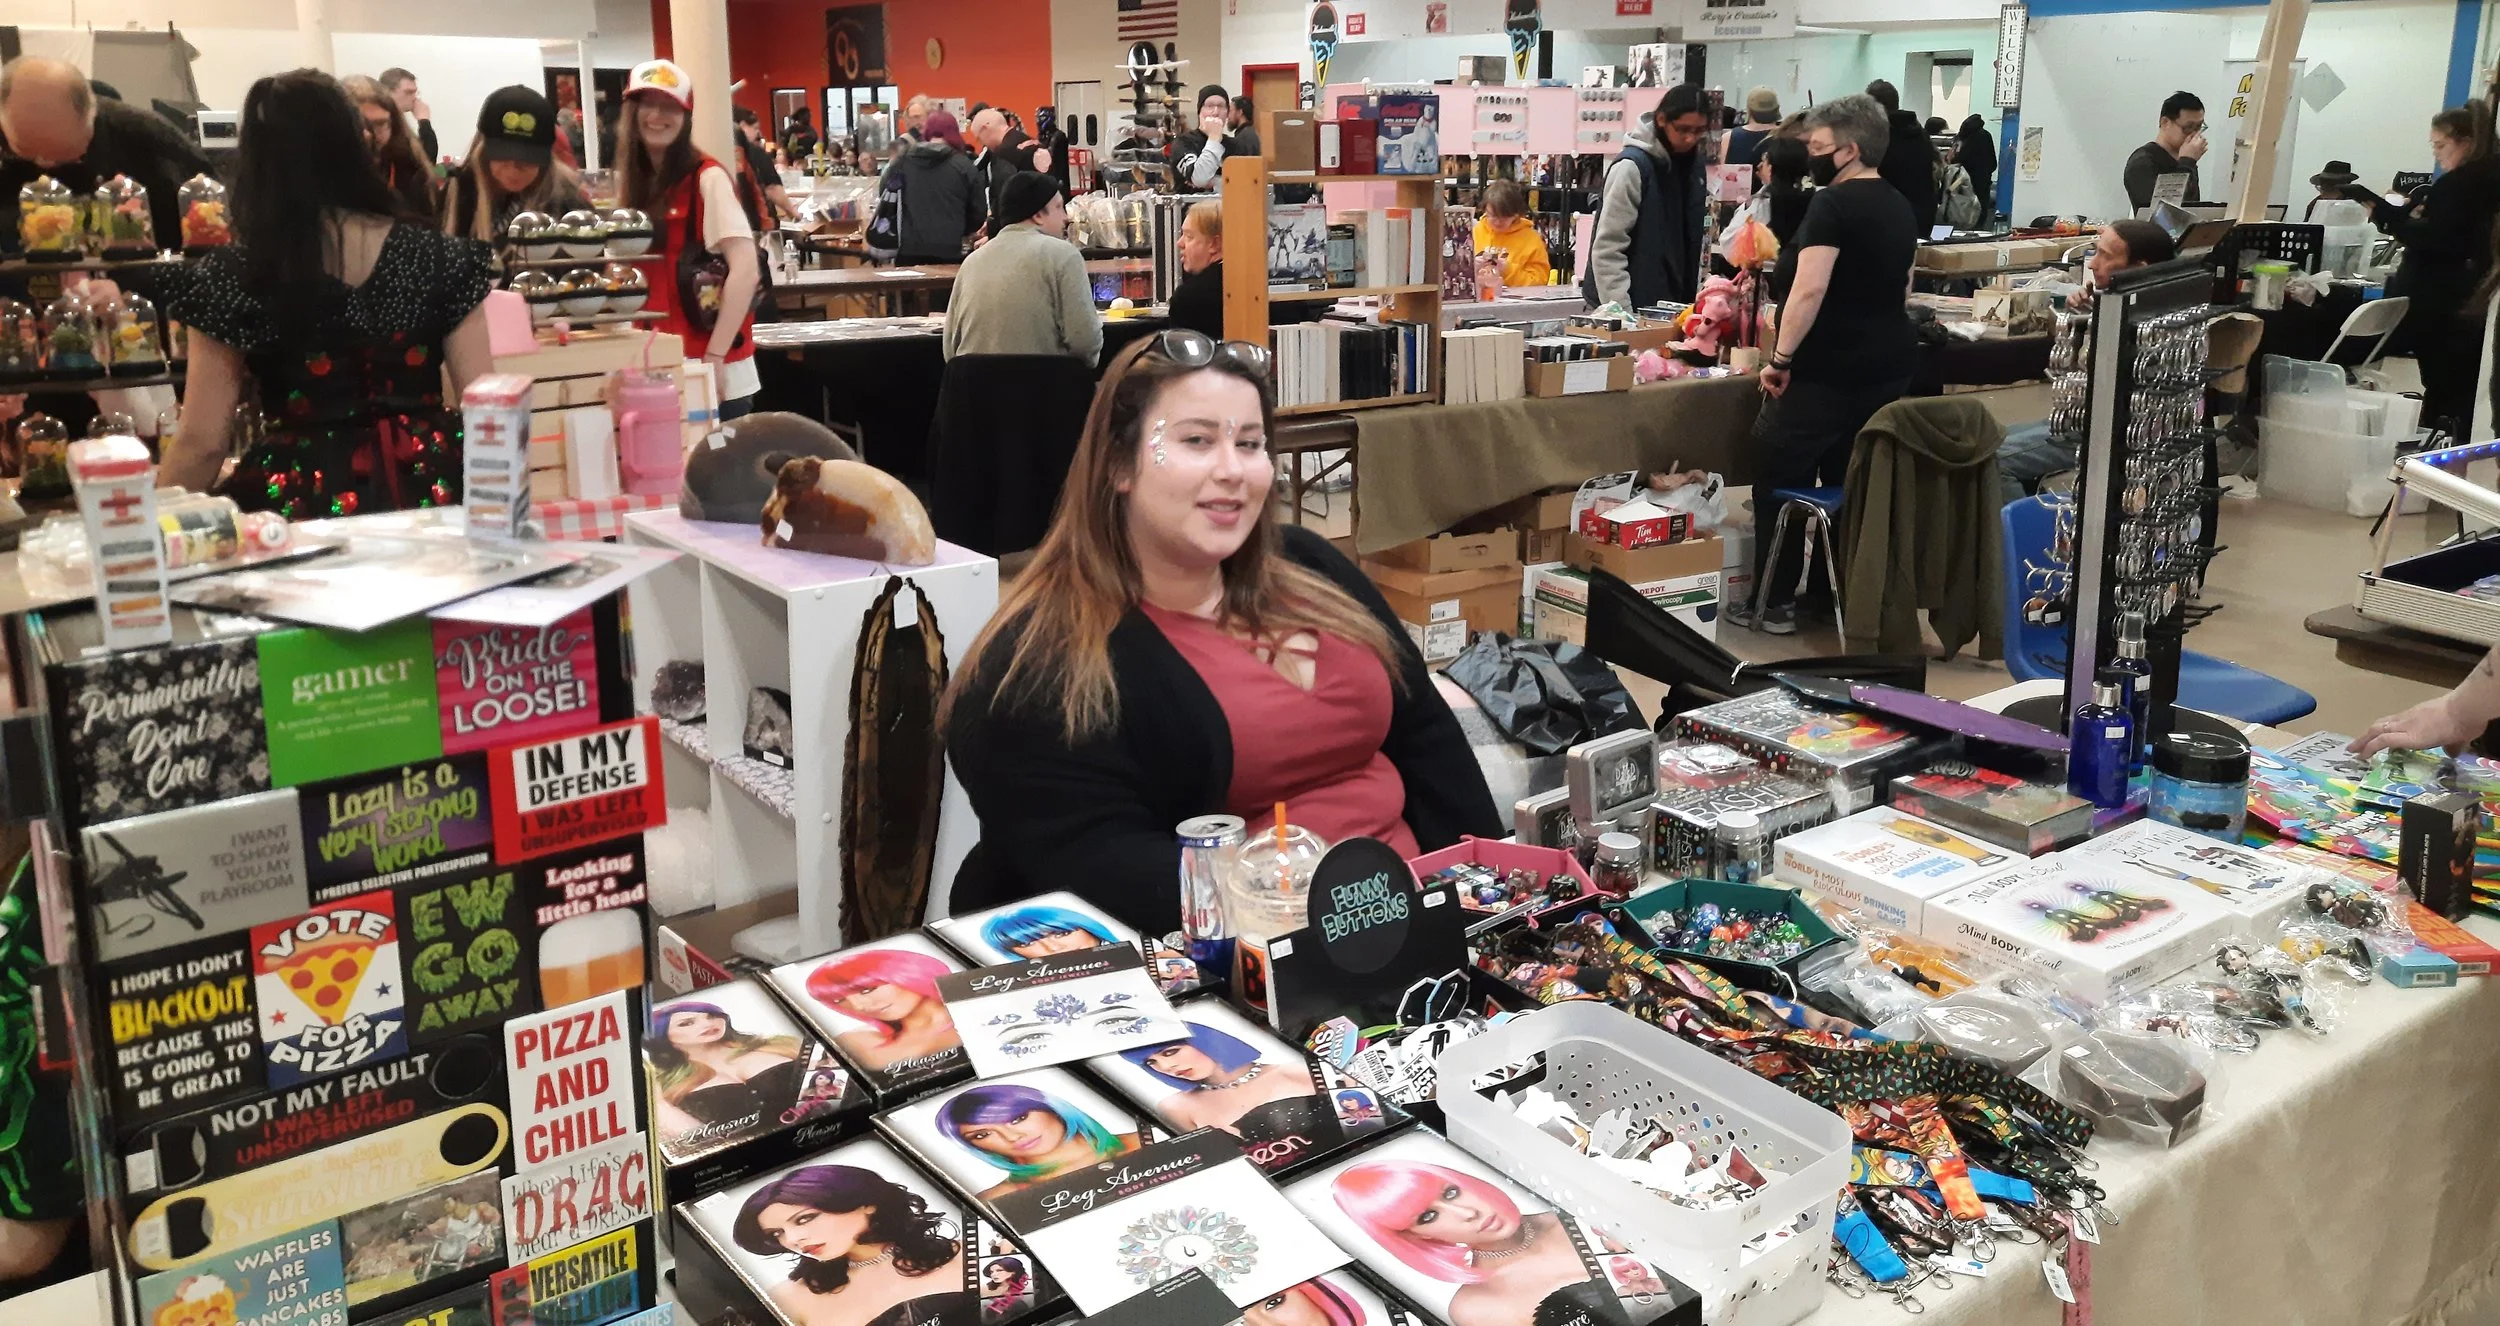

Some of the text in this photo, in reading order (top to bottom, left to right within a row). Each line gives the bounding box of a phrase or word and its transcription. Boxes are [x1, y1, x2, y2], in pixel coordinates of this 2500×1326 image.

[2003, 10, 2020, 101] WELCOME
[1635, 524, 1652, 539] Tim
[1640, 586, 1665, 596] DEPOT
[444, 625, 590, 690] Bride
[485, 661, 573, 694] ON THE
[80, 658, 246, 735] Permanently
[291, 657, 415, 706] gamer
[454, 680, 589, 734] LOOSE!
[128, 709, 210, 764] Don't
[526, 729, 633, 783] IN MY
[147, 755, 212, 799] Care
[328, 763, 460, 828] Lazy is a
[530, 763, 637, 806] DEFENSE
[318, 786, 479, 861] very strong
[520, 790, 646, 835] I WAS LEFT
[520, 812, 648, 852] UNSUPERVISED
[211, 842, 291, 868] TO SHOW
[240, 824, 288, 848] WANT
[373, 829, 446, 873] word
[226, 859, 292, 882] YOU MY
[323, 881, 359, 900] PREFER
[360, 871, 411, 889] SELECTIVE
[414, 852, 489, 880] PARTICIPATION
[545, 854, 634, 889] Looking
[1784, 858, 1847, 887] WORLD'S MOST
[1865, 851, 1897, 869] MOST
[1893, 856, 1949, 878] DRINKING
[1925, 860, 1965, 878] GAMES
[200, 874, 295, 905] PLAYROOM
[410, 872, 515, 943] EW
[537, 884, 647, 926] little head
[565, 876, 618, 900] for a
[1330, 871, 1390, 913] FUNNY
[1813, 879, 1907, 919] RIDICULOUS DRINKING
[260, 909, 392, 959] VOTE
[1322, 893, 1409, 943] BUTTONS
[1877, 910, 1907, 929] GAMES
[1957, 923, 1987, 942] Mind
[1991, 936, 2021, 955] BODY
[111, 950, 244, 995] I HOPE I DON'T
[411, 927, 520, 994] GO
[970, 961, 1103, 992] Leg Avenue
[417, 978, 520, 1033] AWAY
[117, 1018, 254, 1068] BECAUSE THIS
[269, 1019, 402, 1073] PIZZA
[300, 1012, 372, 1049] FOR
[514, 1005, 621, 1069] PIZZA
[1334, 1022, 1345, 1066] KINDA
[125, 1042, 252, 1089] IS GOING TO
[138, 1067, 241, 1108] BE GREAT!
[534, 1056, 610, 1114] AND
[212, 1054, 429, 1136] NOT MY FAULT
[274, 1105, 329, 1136] WAS
[332, 1091, 385, 1119] LEFT
[235, 1099, 415, 1163] UNSUPERVISED
[524, 1101, 627, 1164] CHILL
[1249, 1134, 1312, 1168] eon
[1041, 1156, 1196, 1214] Leg Avenue
[1118, 1170, 1185, 1197] BODY JEWELS
[234, 1229, 333, 1274] WAFFLES
[267, 1259, 306, 1285] ARE
[531, 1238, 629, 1302] VERSATILE
[266, 1277, 310, 1306] JUST
